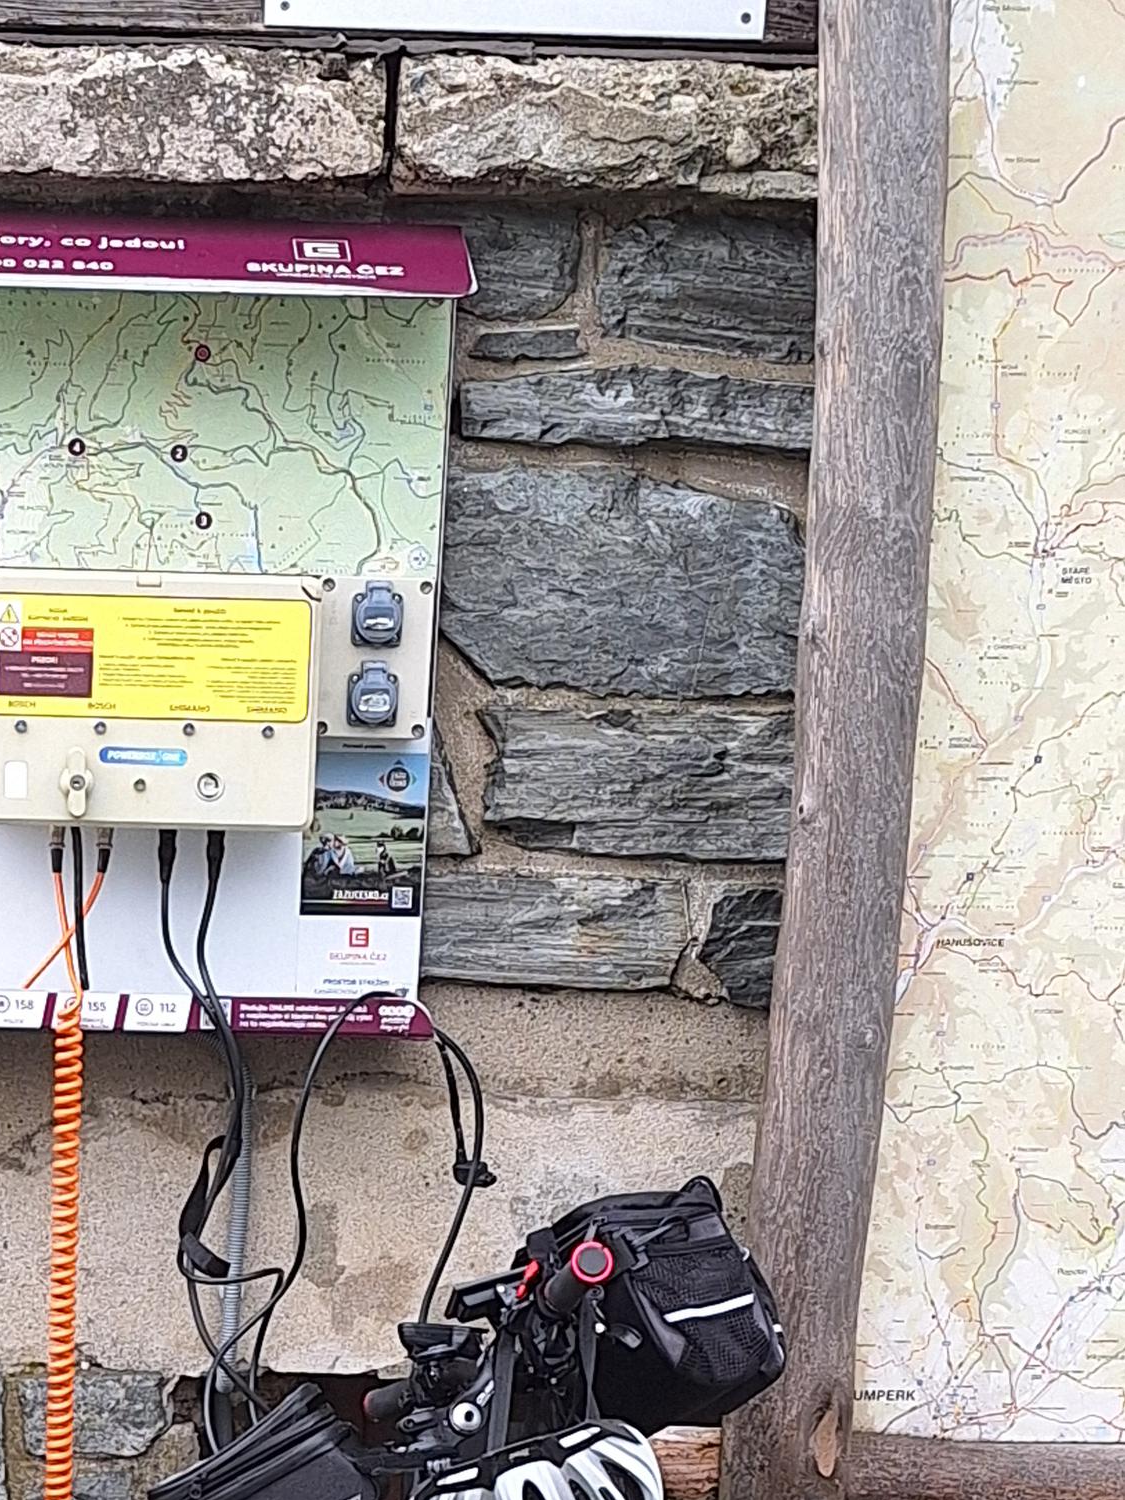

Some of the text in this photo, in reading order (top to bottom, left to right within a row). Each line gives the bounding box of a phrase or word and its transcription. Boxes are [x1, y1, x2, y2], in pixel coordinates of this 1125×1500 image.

[60, 237, 92, 248] co
[246, 261, 352, 275] SKUPINA
[15, 999, 35, 1010] 158
[87, 1000, 107, 1012] 155
[159, 1002, 177, 1013] 112
[853, 1389, 916, 1402] UMPERK
